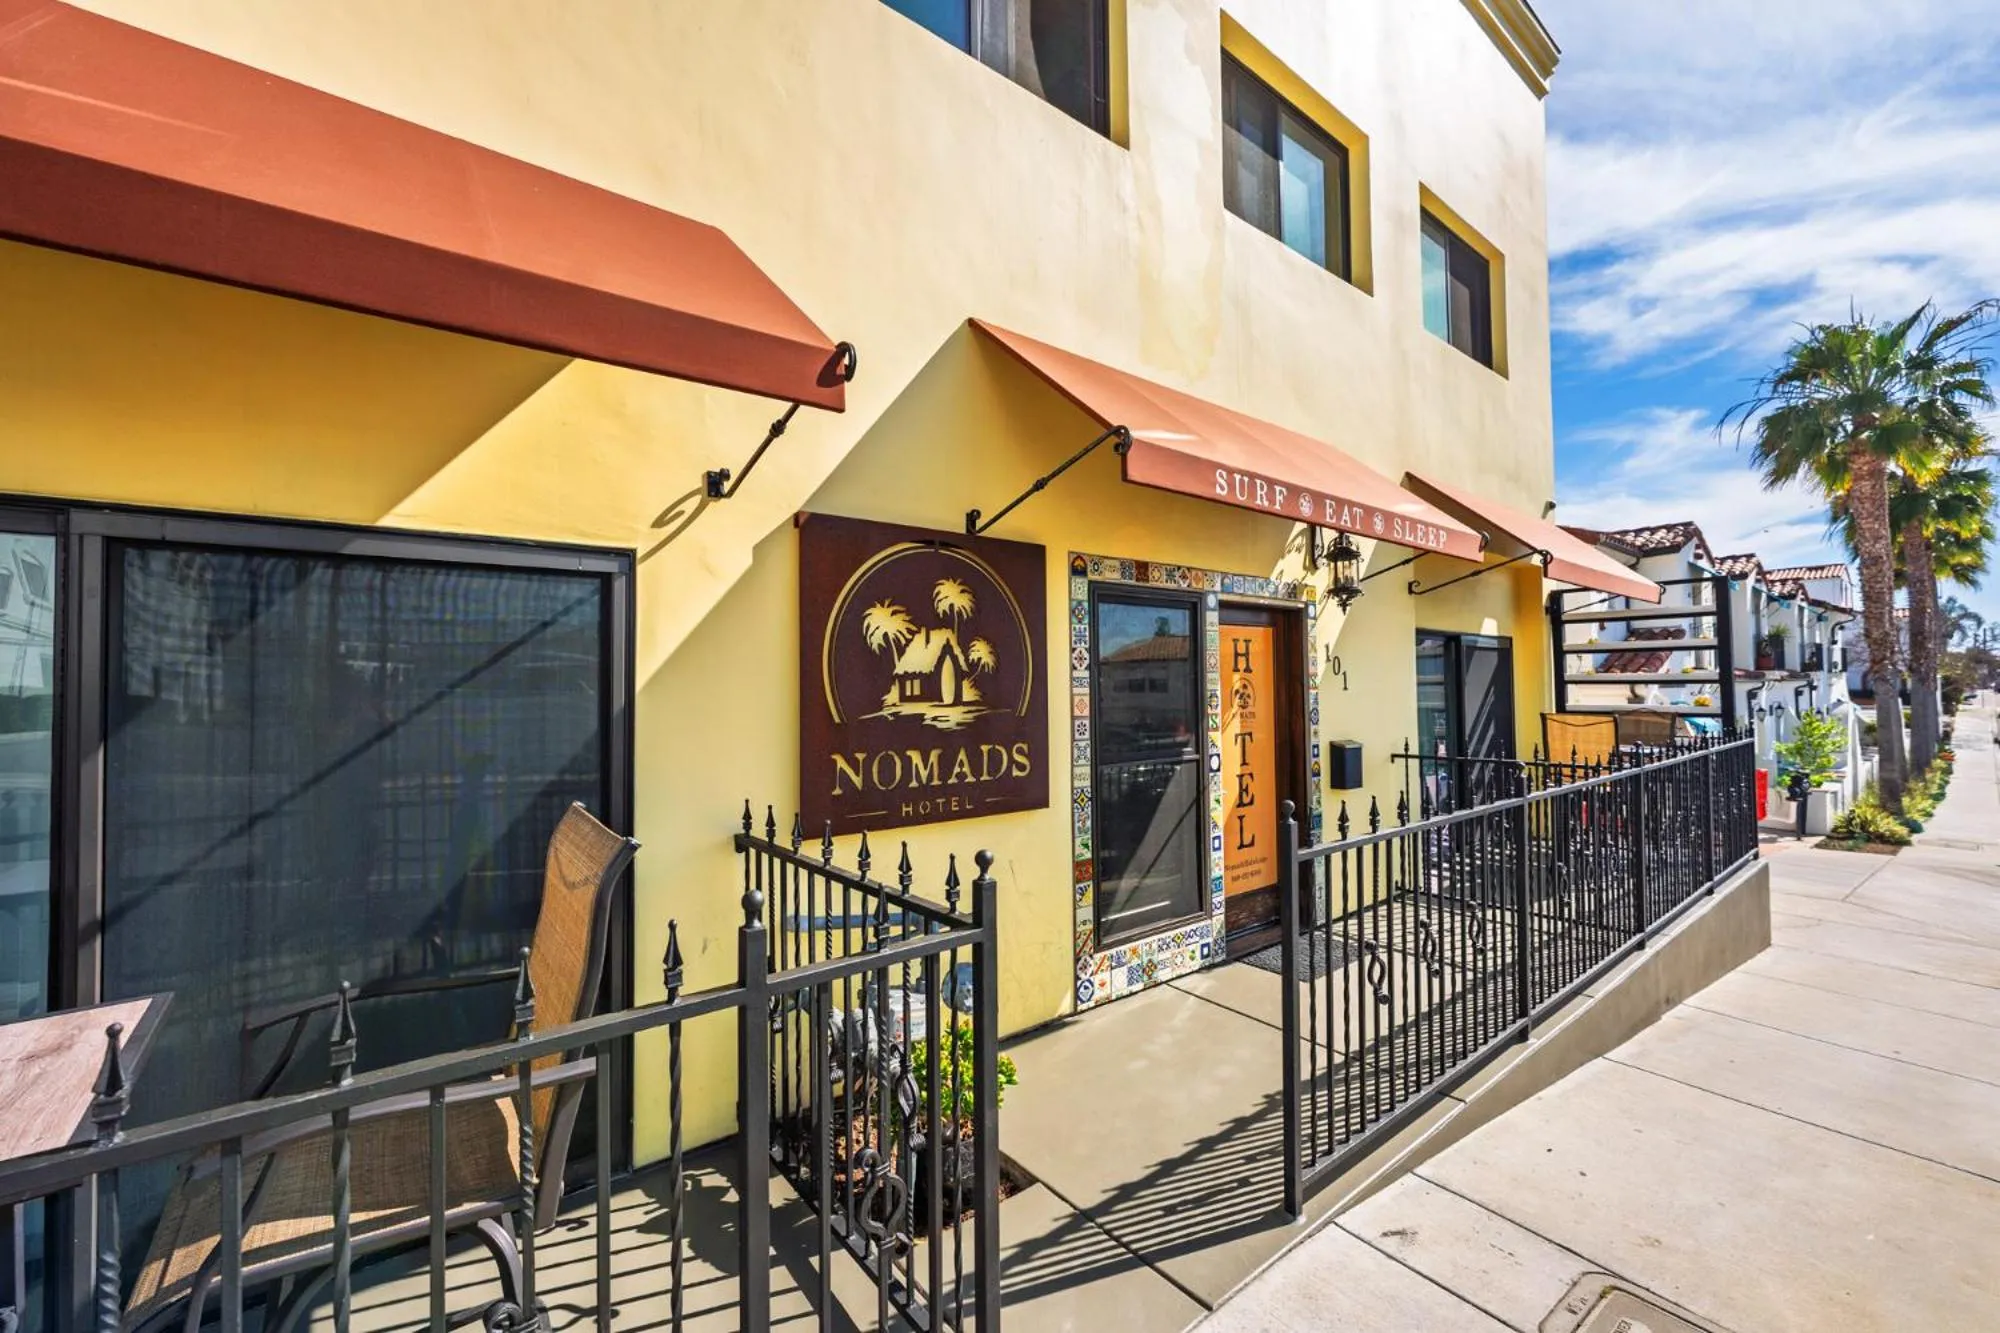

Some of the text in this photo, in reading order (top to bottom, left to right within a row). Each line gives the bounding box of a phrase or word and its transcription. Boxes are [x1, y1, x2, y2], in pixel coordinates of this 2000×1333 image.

[1215, 468, 1448, 549] SURF EAT SLEEP
[1324, 643, 1349, 691] 101
[830, 742, 1031, 796] NOMADS
[901, 797, 975, 817] HOTEL
